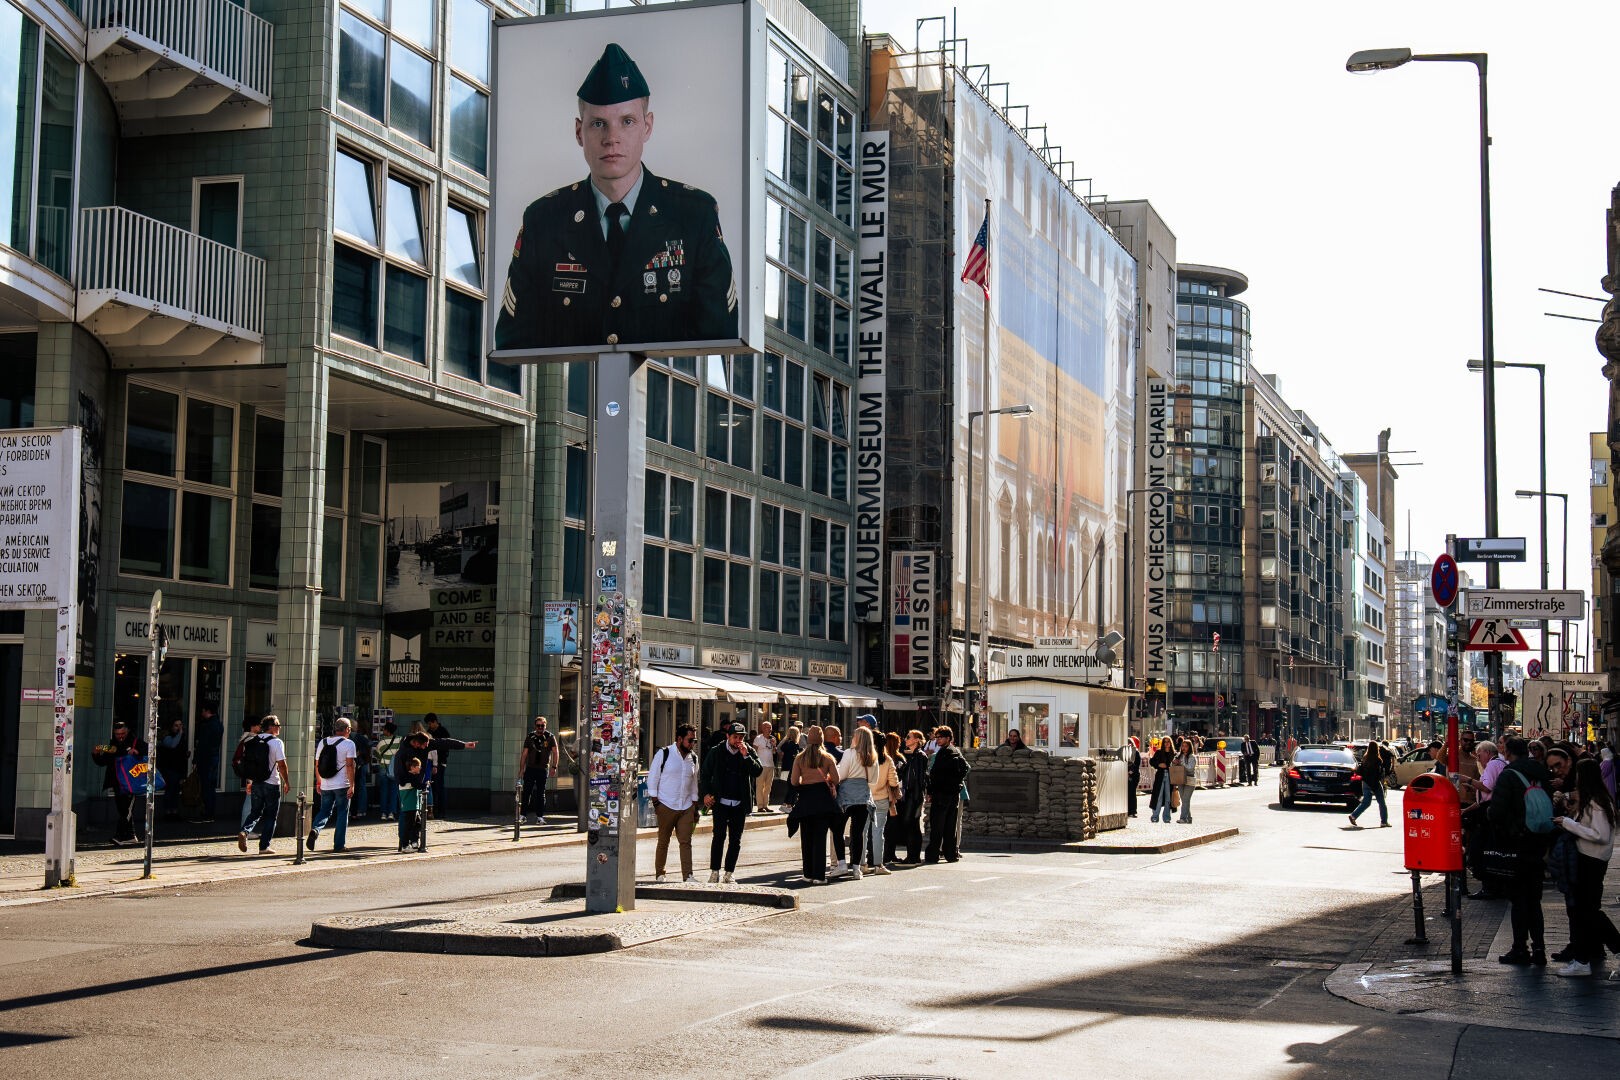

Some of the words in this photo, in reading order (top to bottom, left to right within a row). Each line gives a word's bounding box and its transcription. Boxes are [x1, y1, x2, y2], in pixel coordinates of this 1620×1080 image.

[862, 140, 886, 204] MUR
[861, 211, 885, 239] LE
[559, 281, 579, 289] HARPER
[860, 251, 884, 324] WALL
[858, 331, 883, 379] THE
[1149, 384, 1165, 459] CHARLIE
[21, 434, 52, 448] SECTOR
[6, 448, 51, 462] FORBIDDEN
[0, 464, 7, 476] S
[17, 484, 46, 497] СЕКТОР
[29, 498, 52, 511] ВРЕМЯ
[855, 392, 883, 612] MAUERMUSEUM
[1149, 465, 1165, 582] CHECKPONT
[5, 531, 49, 546] AMÉRICAIN
[12, 548, 21, 559] DU
[22, 547, 51, 559] SERVICE
[17, 583, 47, 597] SEKTOR
[437, 589, 482, 606] COME
[1149, 587, 1164, 618] AM
[1483, 596, 1565, 613] Zimmerstraße
[439, 612, 468, 625] AND
[474, 611, 491, 624] BE
[912, 555, 931, 676] MUSEUM
[183, 625, 219, 643] CHARLIE
[435, 630, 474, 644] PART
[648, 646, 661, 659] WALL
[661, 647, 680, 660] MUSEUM
[1148, 623, 1164, 672] HAUS
[710, 652, 741, 666] MAUERMUSEUM
[761, 657, 782, 670] CHECKPOINT
[782, 659, 797, 672] CHARLIE
[1010, 655, 1023, 668] US
[1026, 655, 1050, 668] ARMY
[389, 663, 420, 674] MAUER
[810, 662, 829, 674] CHECKPOINT
[829, 664, 843, 676] CHARLIE
[388, 673, 420, 683] MUSEUM
[1576, 679, 1600, 687] Museum
